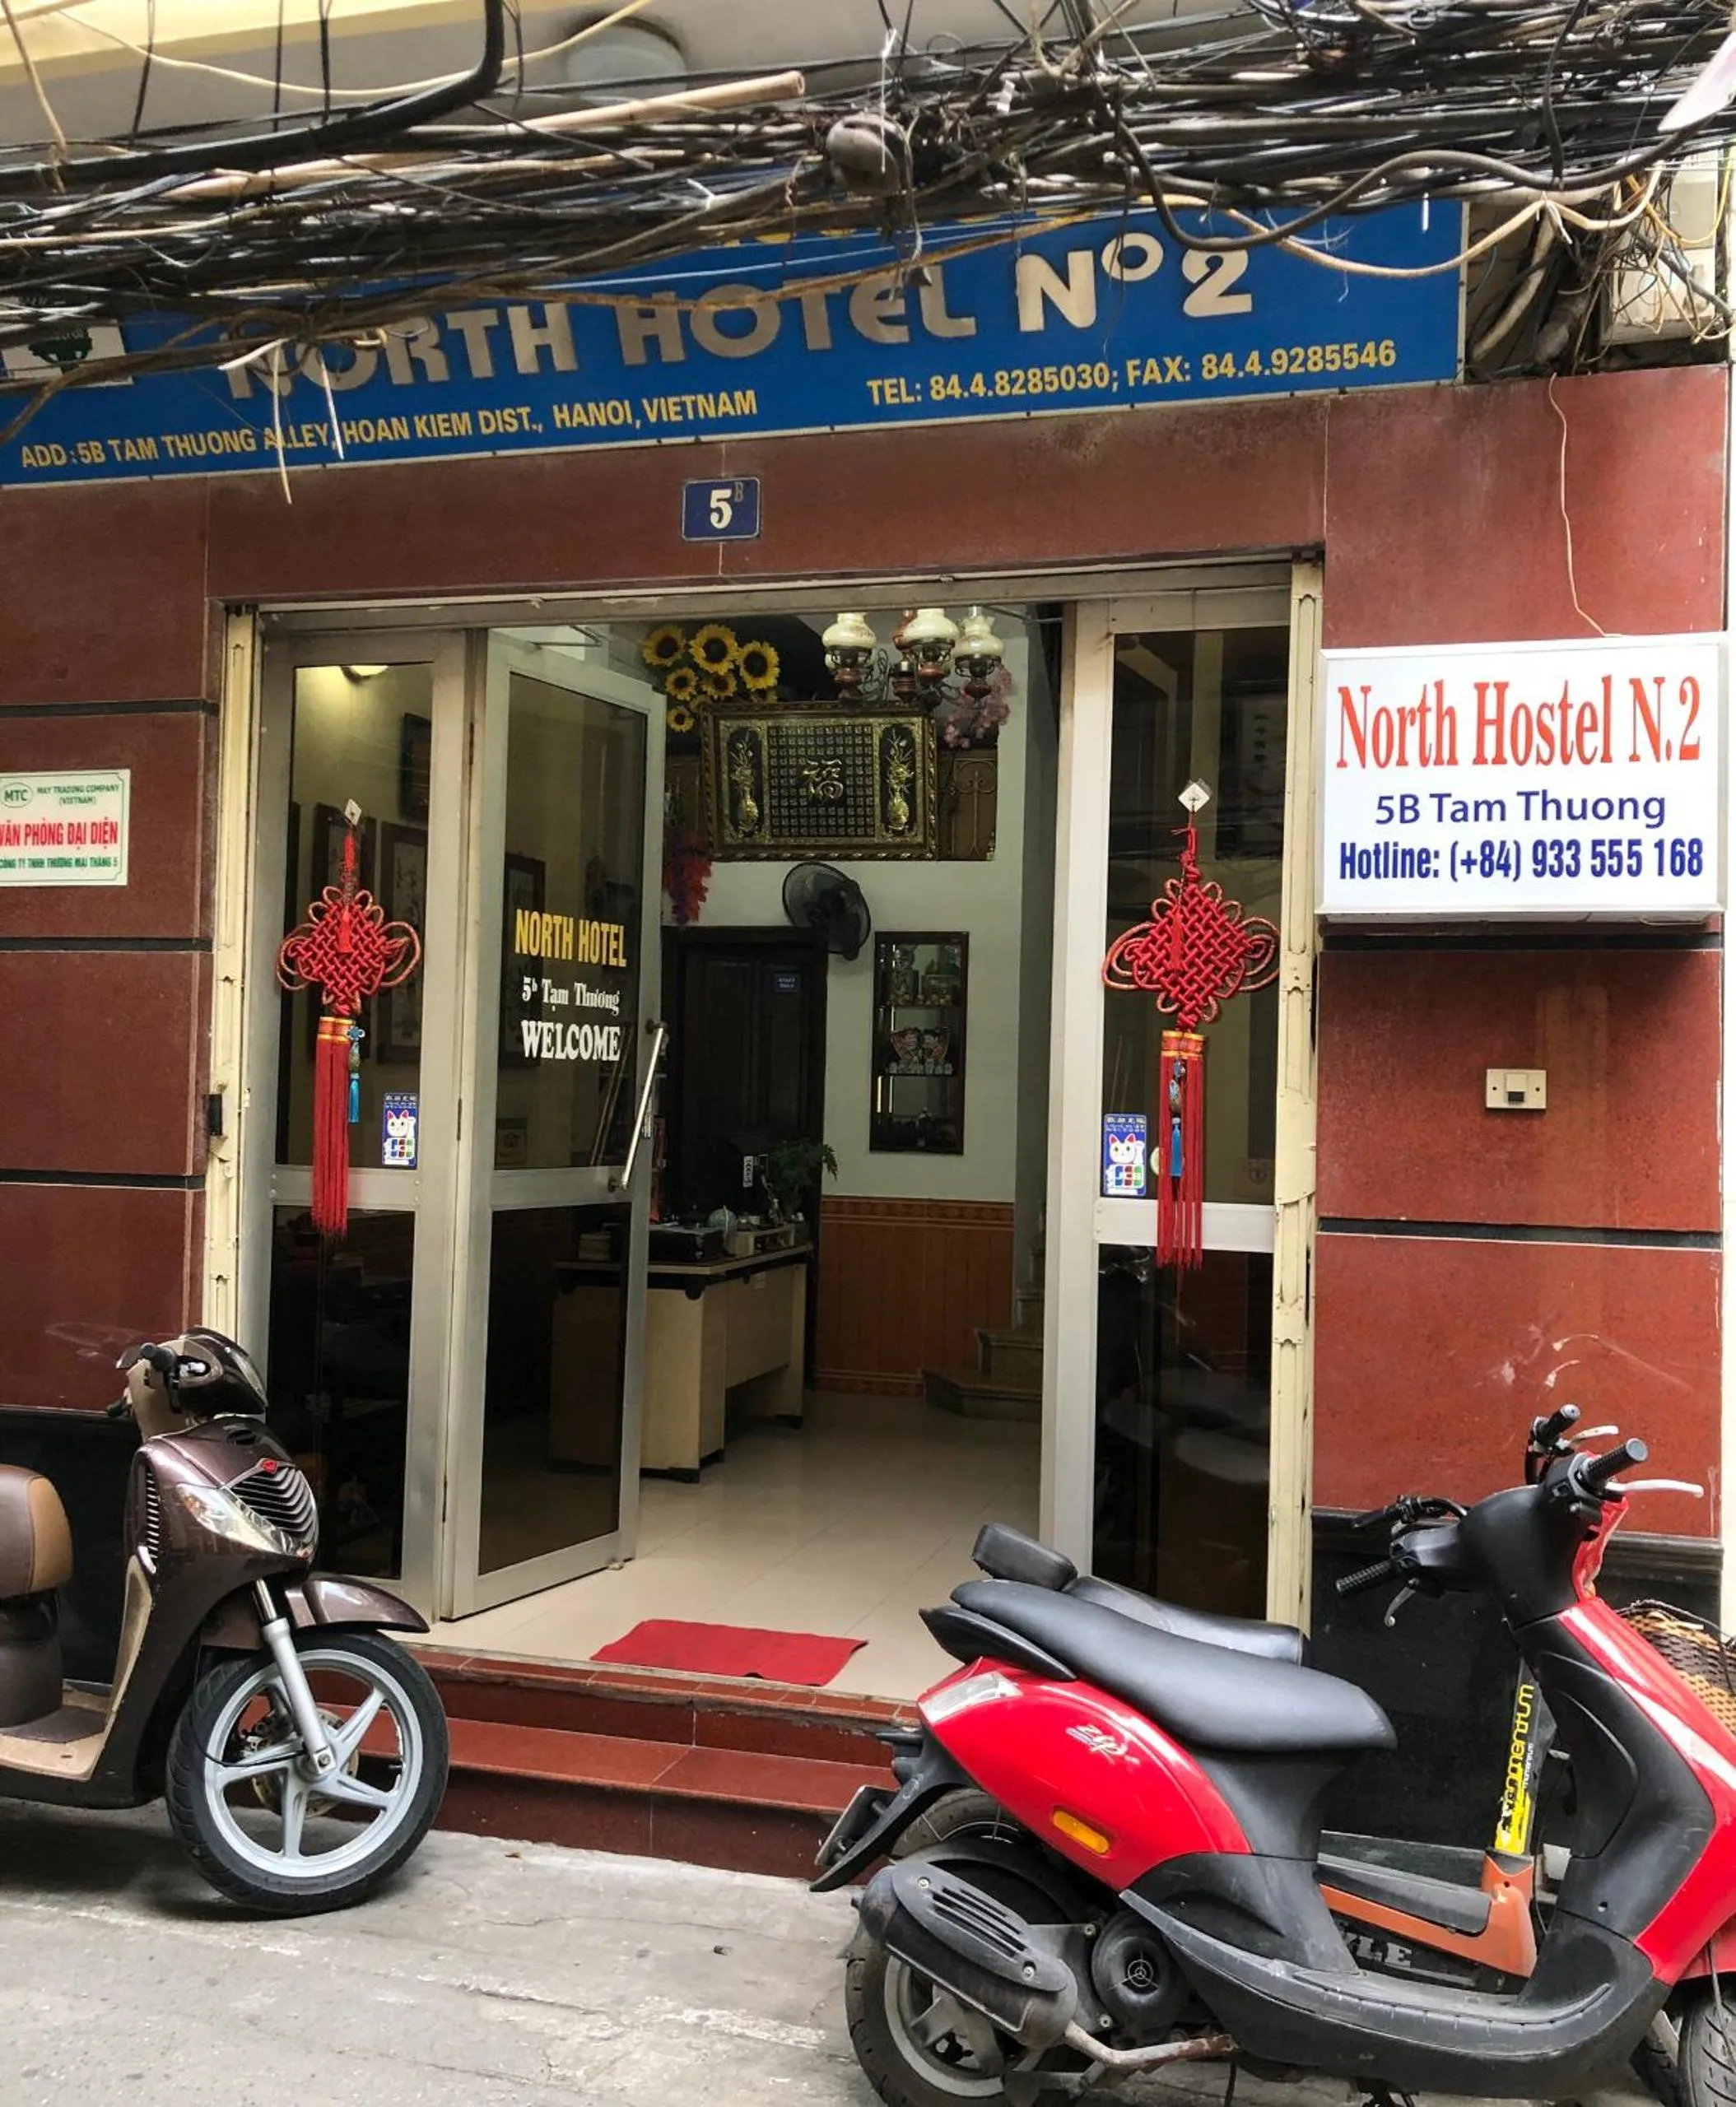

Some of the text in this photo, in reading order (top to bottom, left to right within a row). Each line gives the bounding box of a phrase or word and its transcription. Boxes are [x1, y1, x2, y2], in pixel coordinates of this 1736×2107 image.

[616, 265, 976, 365] HOTEL
[1181, 238, 1253, 319] 2
[108, 435, 159, 460] TAM
[163, 429, 257, 458] THUONG
[342, 416, 410, 444] HOAN
[414, 411, 472, 438] KIEM
[642, 389, 758, 423] VIETNAM
[867, 378, 922, 406] TEL:
[930, 359, 1119, 401] 84.4.8285030;
[1126, 355, 1191, 386] FAX:
[1201, 339, 1397, 380] 84.4.9285546
[1337, 679, 1459, 769] North
[1472, 674, 1613, 766] Hostel
[1629, 676, 1701, 763] N.2
[4, 789, 29, 802] MTC
[1375, 789, 1666, 829] 5B Tam Thuong
[1340, 837, 1703, 882] Hotline: (+84) 933 555 168
[515, 909, 627, 967] NORTH HOTEL
[521, 1020, 621, 1062] WELCOME
